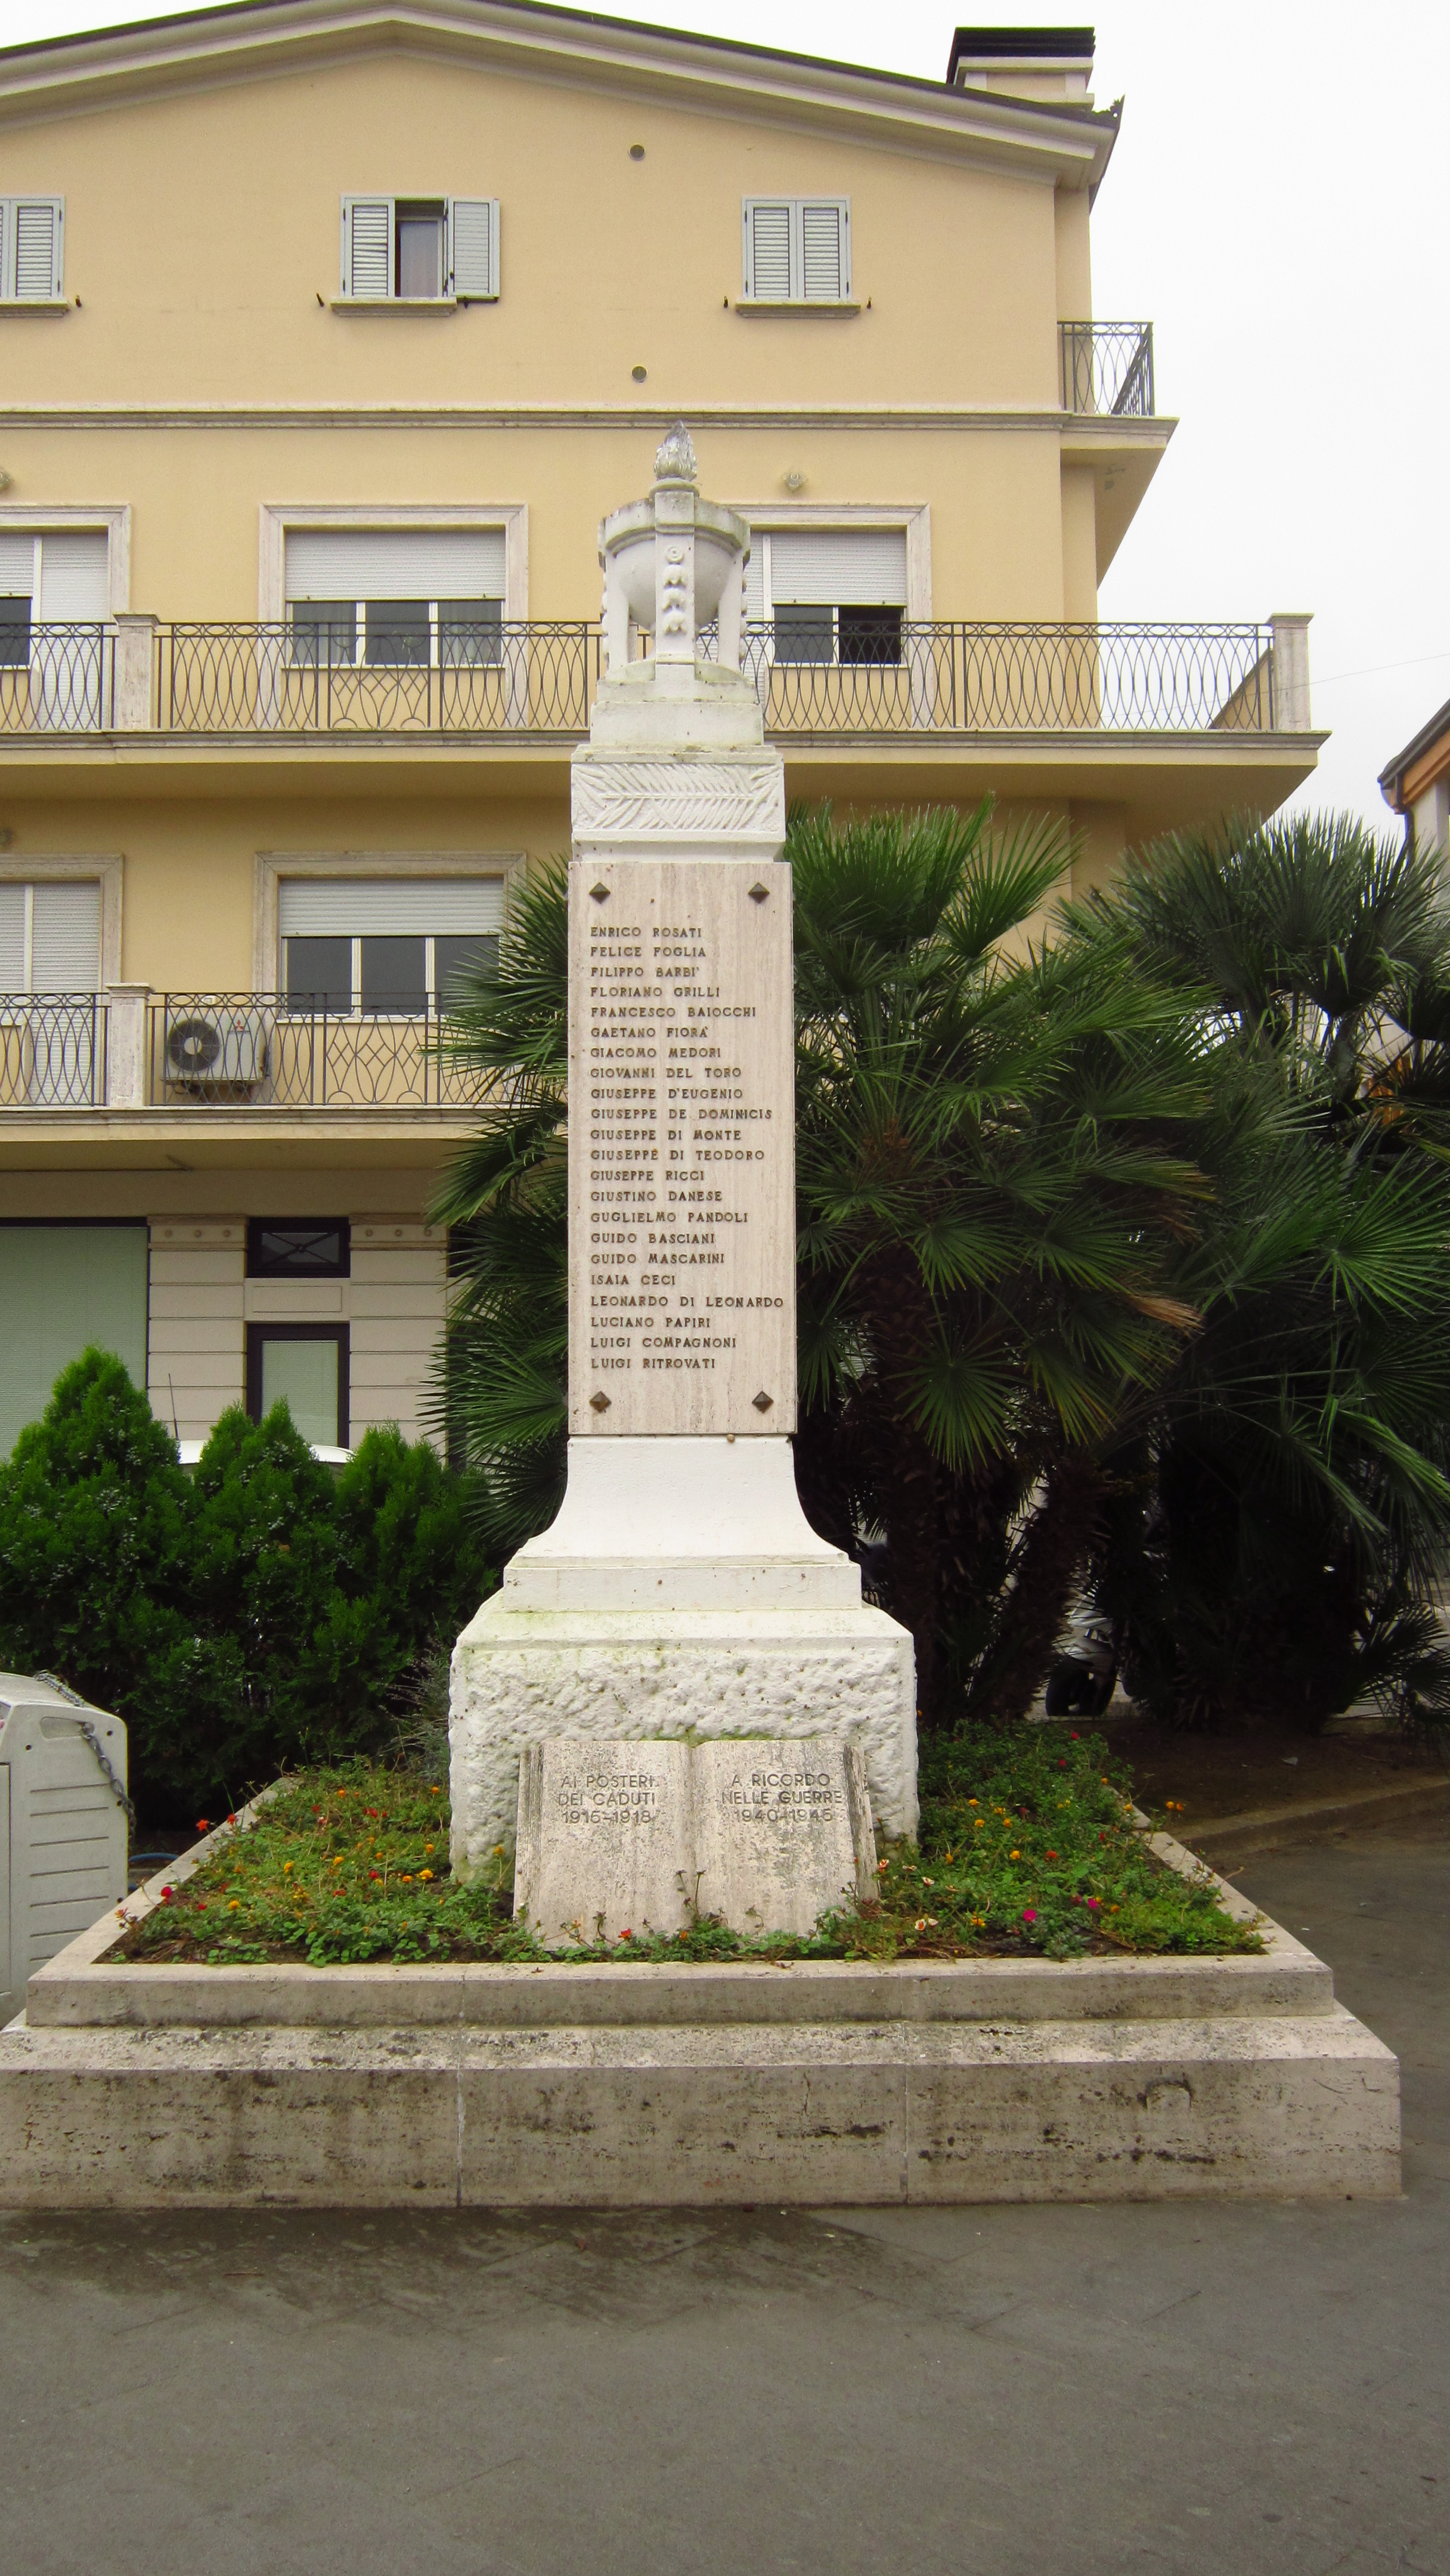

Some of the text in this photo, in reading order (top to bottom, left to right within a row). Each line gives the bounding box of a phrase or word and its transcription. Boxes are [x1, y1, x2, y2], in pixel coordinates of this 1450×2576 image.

[590, 926, 702, 938] ENRICO ROSATI
[590, 946, 707, 958] FELICE FOGLIA
[590, 967, 644, 978] FILIPPO
[590, 986, 720, 998] FLORIANO GRILLI
[591, 1007, 756, 1018] FRANCESCO BAIOCCHI
[590, 1027, 656, 1038] GAETANO
[590, 1047, 721, 1058] GIACOMO MEDORI
[590, 1067, 742, 1079] GIOVANNI DEL TORO
[590, 1088, 656, 1100] GIUSEPPE
[591, 1109, 772, 1120] GIUSEPPE DE DOMINICIS
[590, 1129, 742, 1141] GIUSEPPE DI MONTE
[590, 1149, 764, 1161] GIUSEPPE DI TEODORO
[590, 1170, 704, 1182] GIUSEPPE RICCI
[590, 1190, 723, 1202] GIUSTINO DANESE
[590, 1211, 748, 1224] GUGLIELMO PANDOLI
[590, 1233, 715, 1244] GUIDO BASCIANI
[590, 1253, 724, 1265] GUIDO MASCARINI
[591, 1274, 676, 1286] ISAIA CECI
[591, 1295, 783, 1309] LEONARDO DI LEONARDO
[591, 1316, 710, 1329] LUCIANO PAPIRI
[590, 1336, 736, 1349] LUIGI COMPAGNONI
[591, 1358, 715, 1370] LUIGI RITROVATI
[560, 1775, 654, 1788] AI POSTERI
[731, 1773, 831, 1787] A RICORDO
[558, 1792, 655, 1806] DEI CADUTI
[721, 1790, 842, 1804] NELLE GUERRE
[562, 1809, 652, 1824] 1915-1918
[733, 1807, 833, 1822] 1940-1945
